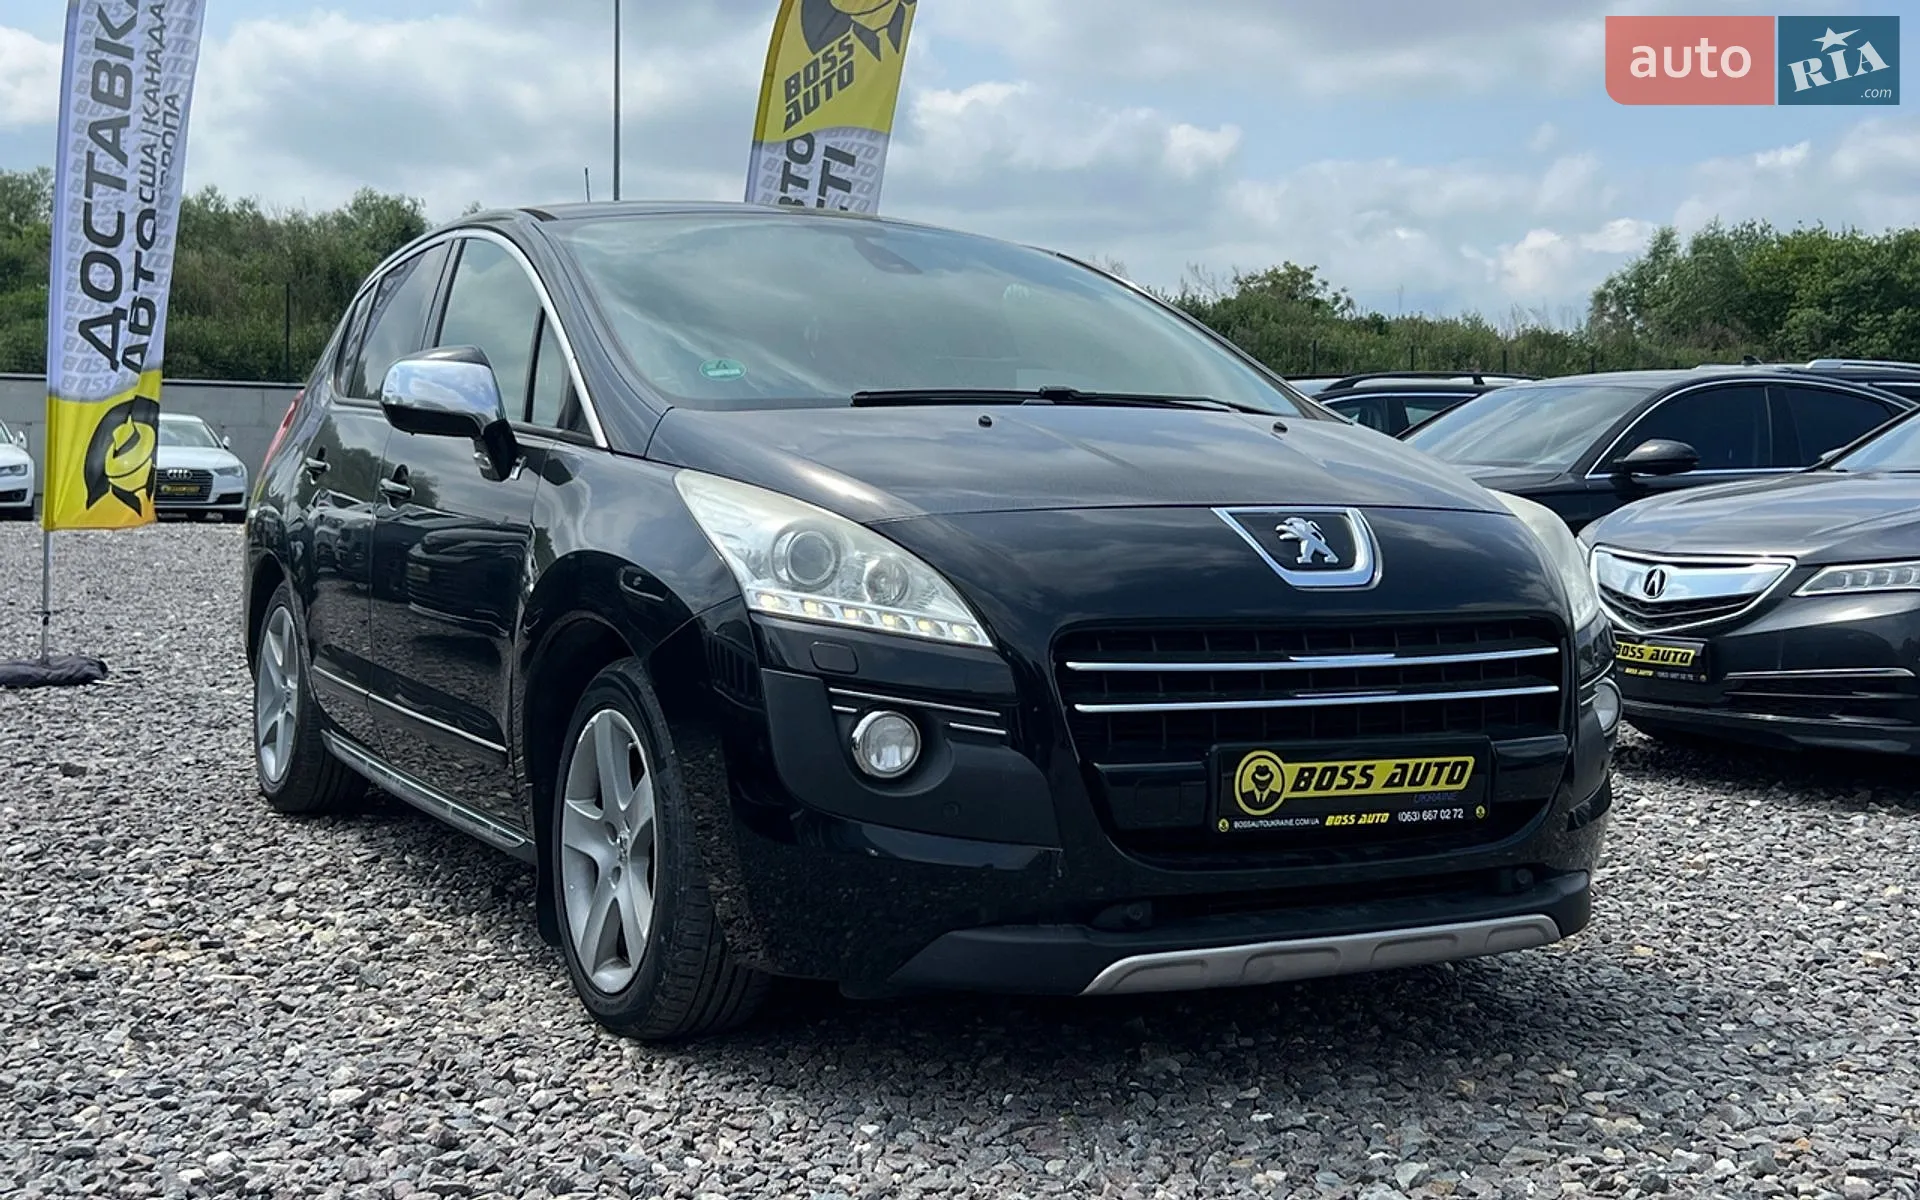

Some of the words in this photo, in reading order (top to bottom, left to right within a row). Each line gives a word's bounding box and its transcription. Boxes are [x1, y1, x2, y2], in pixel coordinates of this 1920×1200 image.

[142, 3, 167, 125] КАНАДА
[784, 34, 854, 104] BOSS
[783, 60, 854, 134] AUTO
[79, 0, 140, 373] ДОСТАВК
[139, 143, 158, 204] США
[1649, 649, 1692, 664] AUTO
[1291, 764, 1376, 793] BOSS
[1382, 760, 1470, 789] AUTO
[1325, 814, 1356, 826] BOSS
[1357, 812, 1390, 825] AUTO
[1398, 811, 1420, 822] (063)
[1422, 810, 1438, 821] 667
[1440, 808, 1451, 819] 02
[1452, 808, 1464, 819] 72
